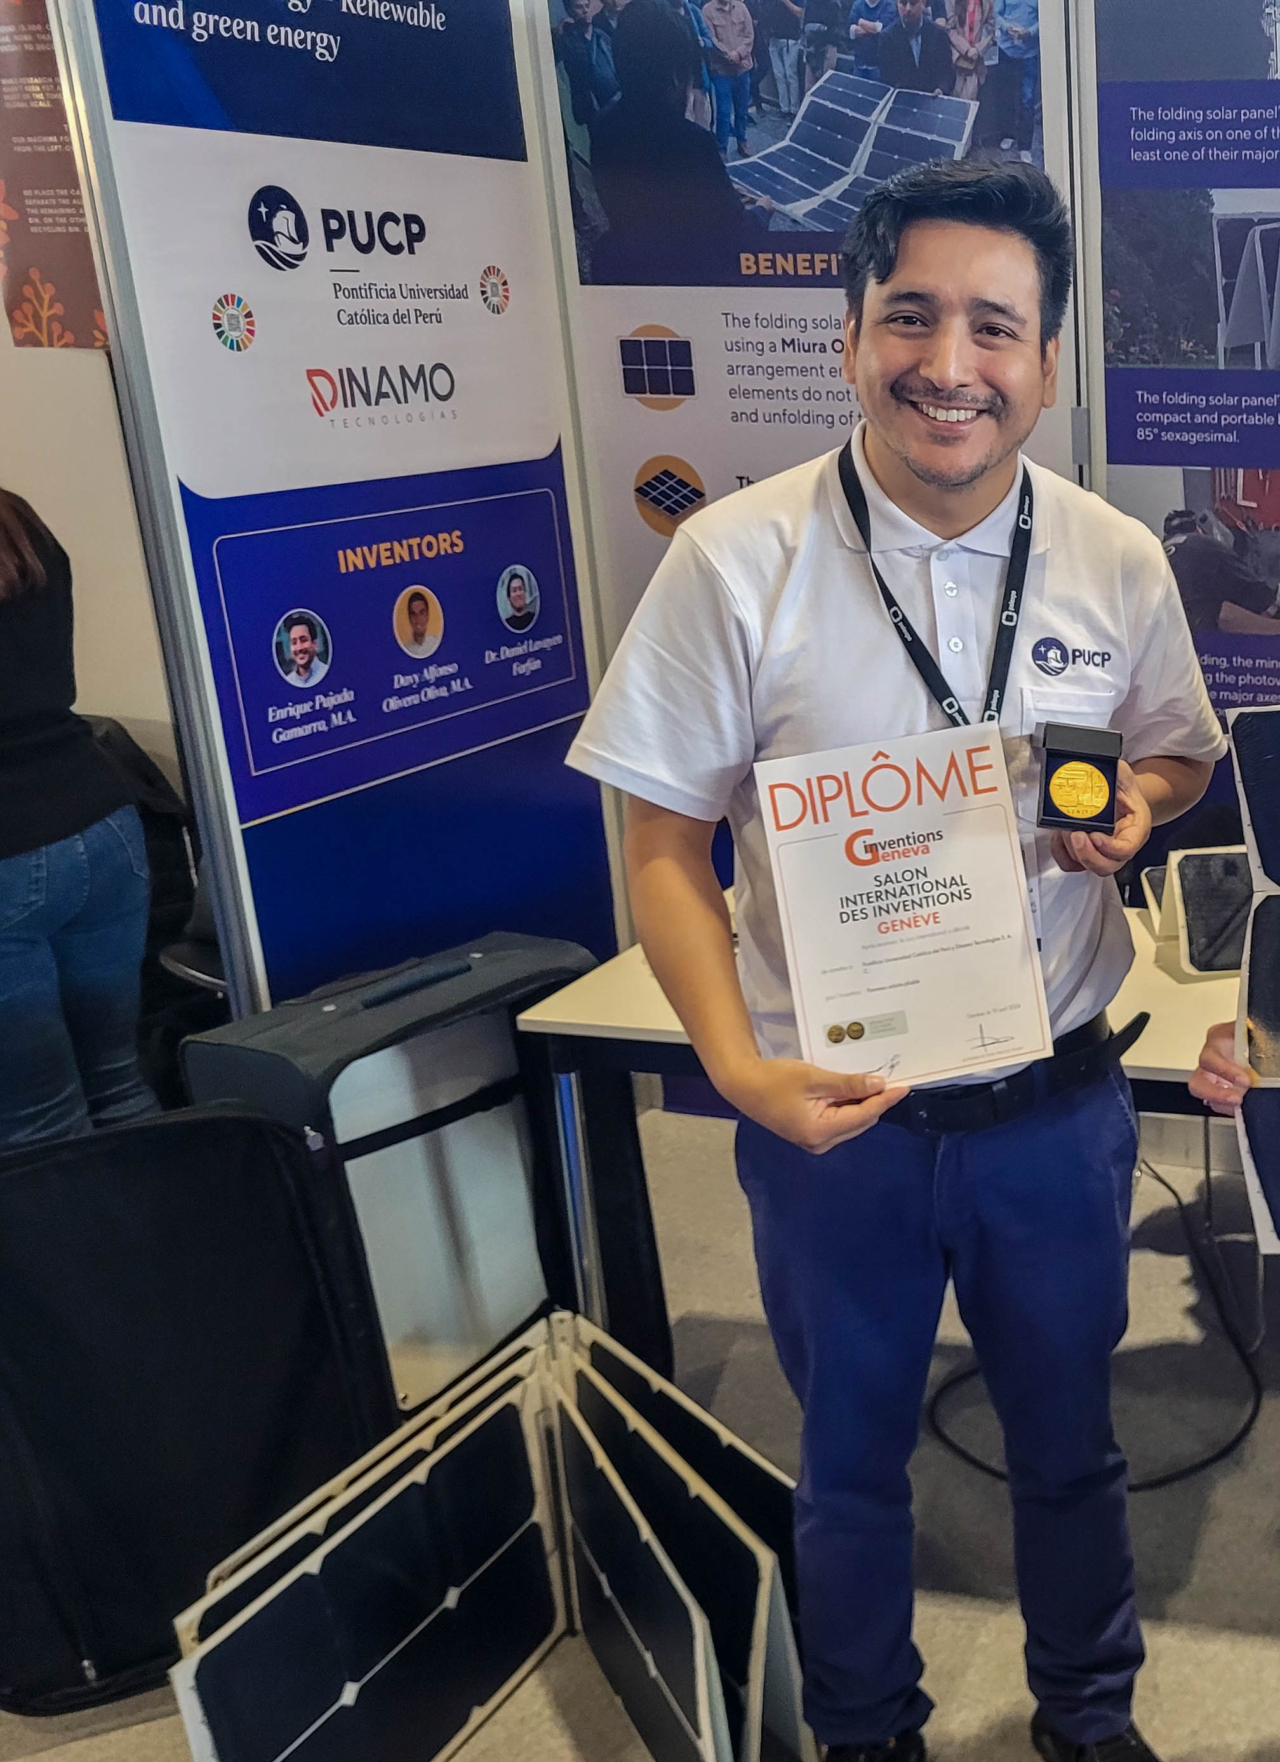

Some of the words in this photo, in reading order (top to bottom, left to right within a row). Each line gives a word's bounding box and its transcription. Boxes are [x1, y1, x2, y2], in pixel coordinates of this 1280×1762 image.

[341, 0, 447, 31] Renewable
[134, 1, 185, 30] and
[192, 12, 260, 42] green
[267, 24, 341, 62] energy
[1129, 106, 1155, 121] The
[1157, 106, 1204, 124] folding
[1206, 105, 1238, 121] solar
[1130, 126, 1176, 144] folding
[1178, 130, 1204, 141] axis
[1205, 129, 1223, 141] on
[1225, 129, 1252, 141] one
[1254, 125, 1268, 140] of
[1130, 147, 1162, 162] least
[1163, 150, 1190, 162] one
[1191, 146, 1206, 161] of
[1208, 146, 1240, 162] their
[1241, 149, 1280, 164] major
[321, 208, 426, 256] PUCP
[332, 282, 397, 302] Pontificia
[398, 283, 470, 301] Universidad
[336, 308, 391, 327] Católica
[393, 309, 413, 326] del
[415, 307, 444, 325] Perú
[720, 312, 751, 329] The
[754, 312, 808, 334] folding
[724, 338, 765, 357] using
[768, 341, 777, 353] a
[781, 337, 828, 354] Miura
[726, 363, 826, 381] arrangement
[305, 362, 456, 418] DINAMO
[728, 383, 799, 401] elements
[802, 385, 822, 402] do
[826, 388, 852, 403] not
[1135, 390, 1160, 404] The
[1162, 391, 1207, 409] folding
[1208, 392, 1239, 406] solar
[329, 408, 459, 430] TECNOLOGÍAS
[730, 408, 759, 423] and
[762, 408, 835, 430] unfolding
[838, 409, 854, 426] of
[1136, 411, 1192, 426] compact
[1194, 411, 1218, 424] and
[1220, 412, 1275, 427] portable
[1136, 427, 1159, 441] 85°
[1160, 429, 1240, 446] sexagesimal.
[337, 530, 464, 574] INVENTORS
[1071, 648, 1112, 669] PUCP
[1232, 655, 1254, 668] the
[267, 700, 314, 723] Enrique
[271, 719, 329, 745] Gamarra,
[330, 708, 358, 729] M.A.
[767, 744, 998, 832] DIPLÔME
[844, 828, 931, 867] Geneva
[862, 827, 944, 855] inventions
[873, 866, 929, 889] SALON
[838, 874, 969, 910] INTERNATIONAL
[838, 905, 869, 925] DES
[872, 887, 973, 919] INVENTIONS
[877, 911, 942, 935] GENÈVE
